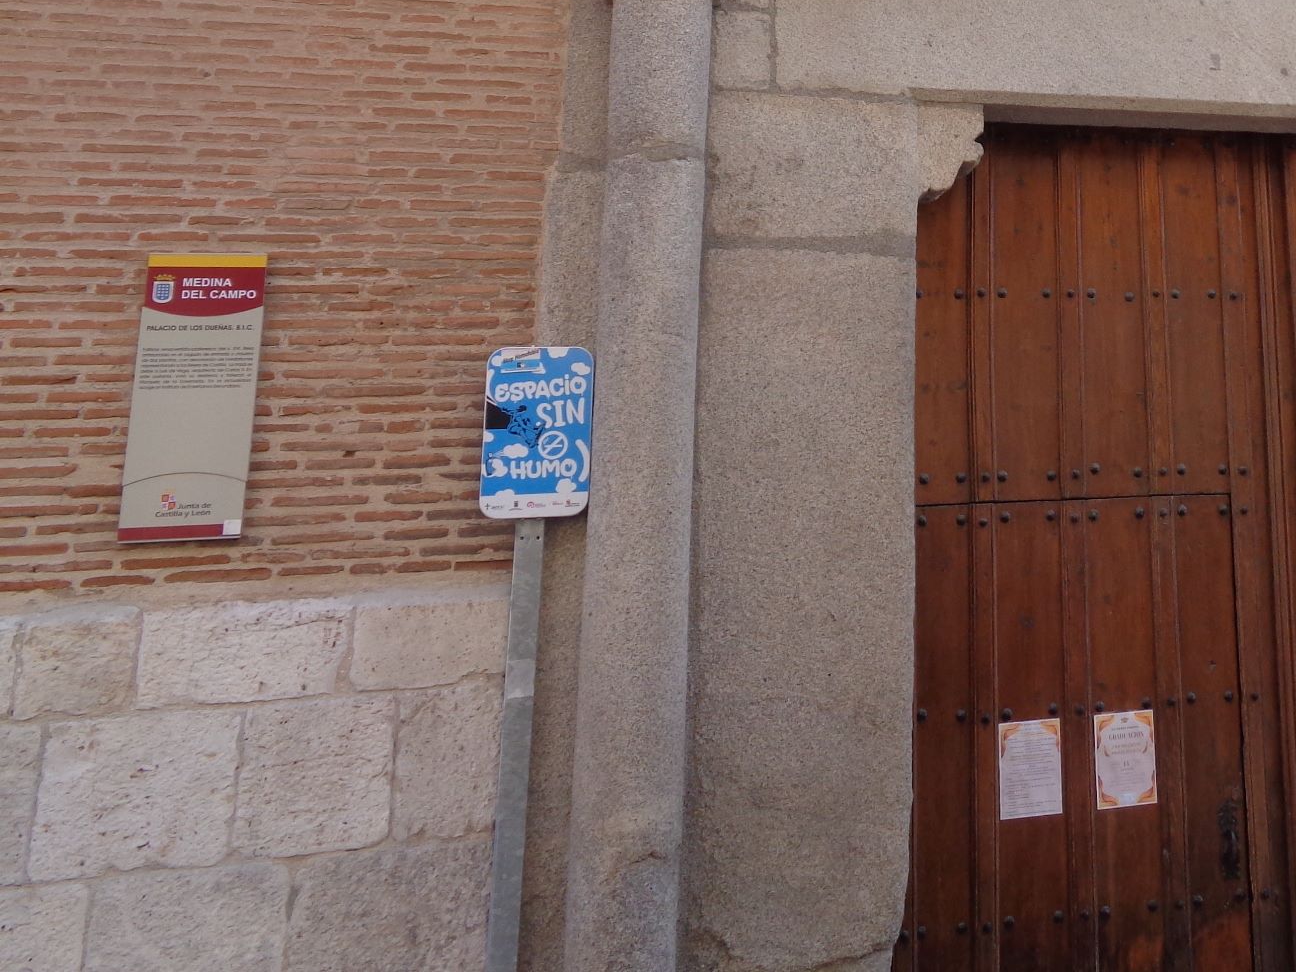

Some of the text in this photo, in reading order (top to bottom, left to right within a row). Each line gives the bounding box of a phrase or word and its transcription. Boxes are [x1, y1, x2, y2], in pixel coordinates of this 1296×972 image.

[182, 277, 232, 287] MEDINA
[181, 289, 257, 299] DEL CAMPO
[535, 397, 585, 428] SIN
[510, 458, 578, 480] HUMO
